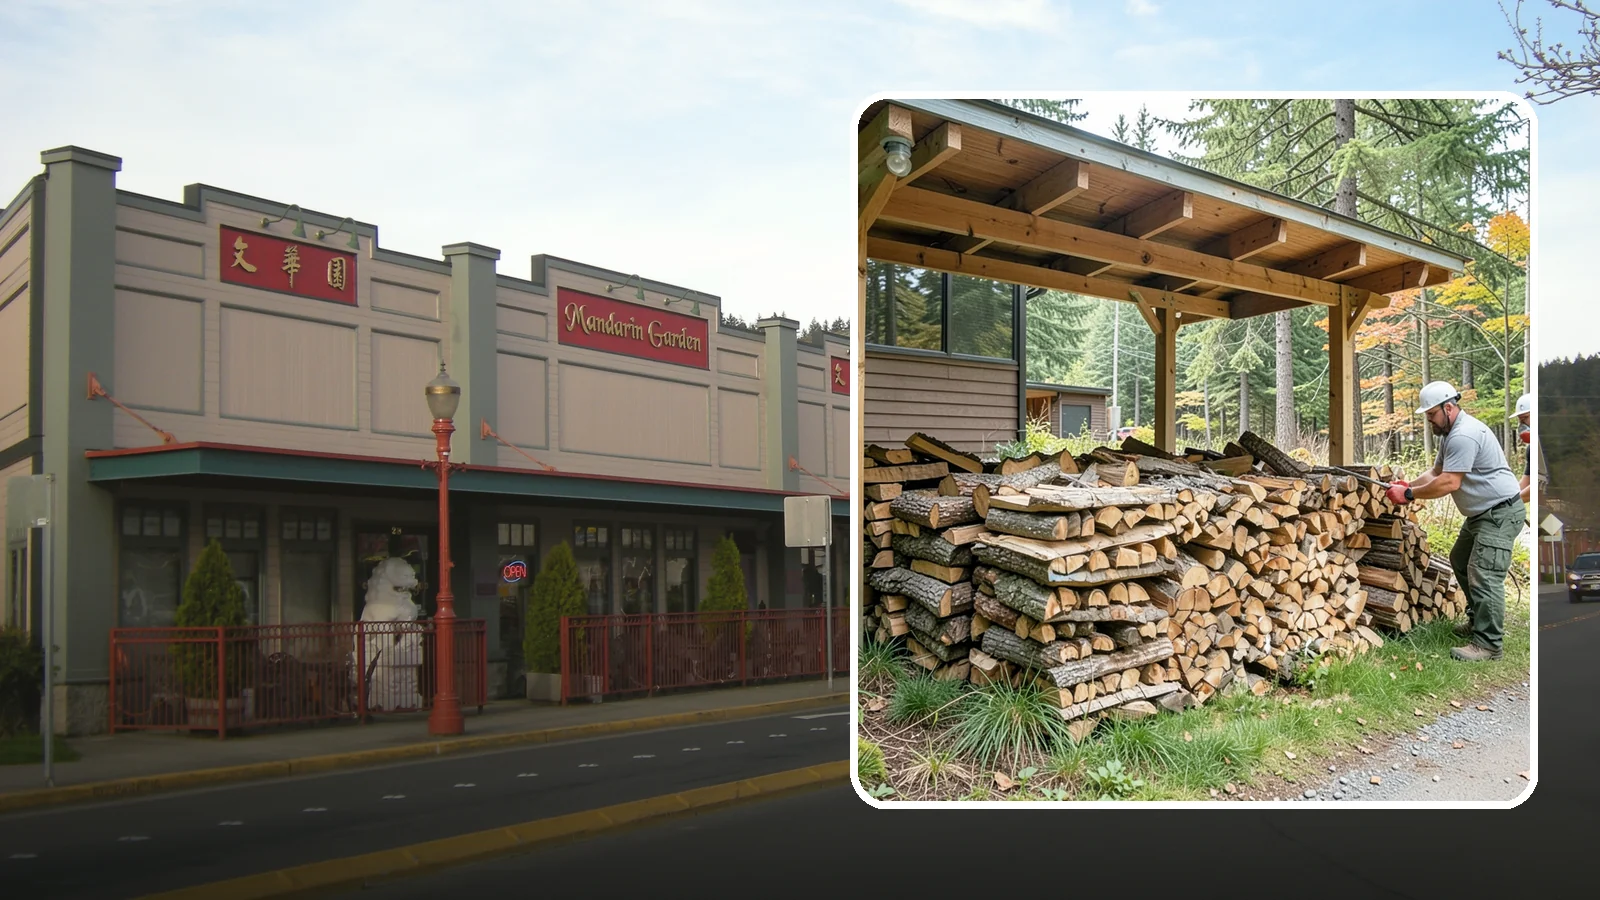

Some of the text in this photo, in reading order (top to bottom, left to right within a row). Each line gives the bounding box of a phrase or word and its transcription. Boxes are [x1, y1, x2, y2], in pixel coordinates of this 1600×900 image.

[231, 236, 346, 290] 文華園
[564, 302, 702, 352] Mandarin Garden
[503, 565, 527, 578] OPEN
